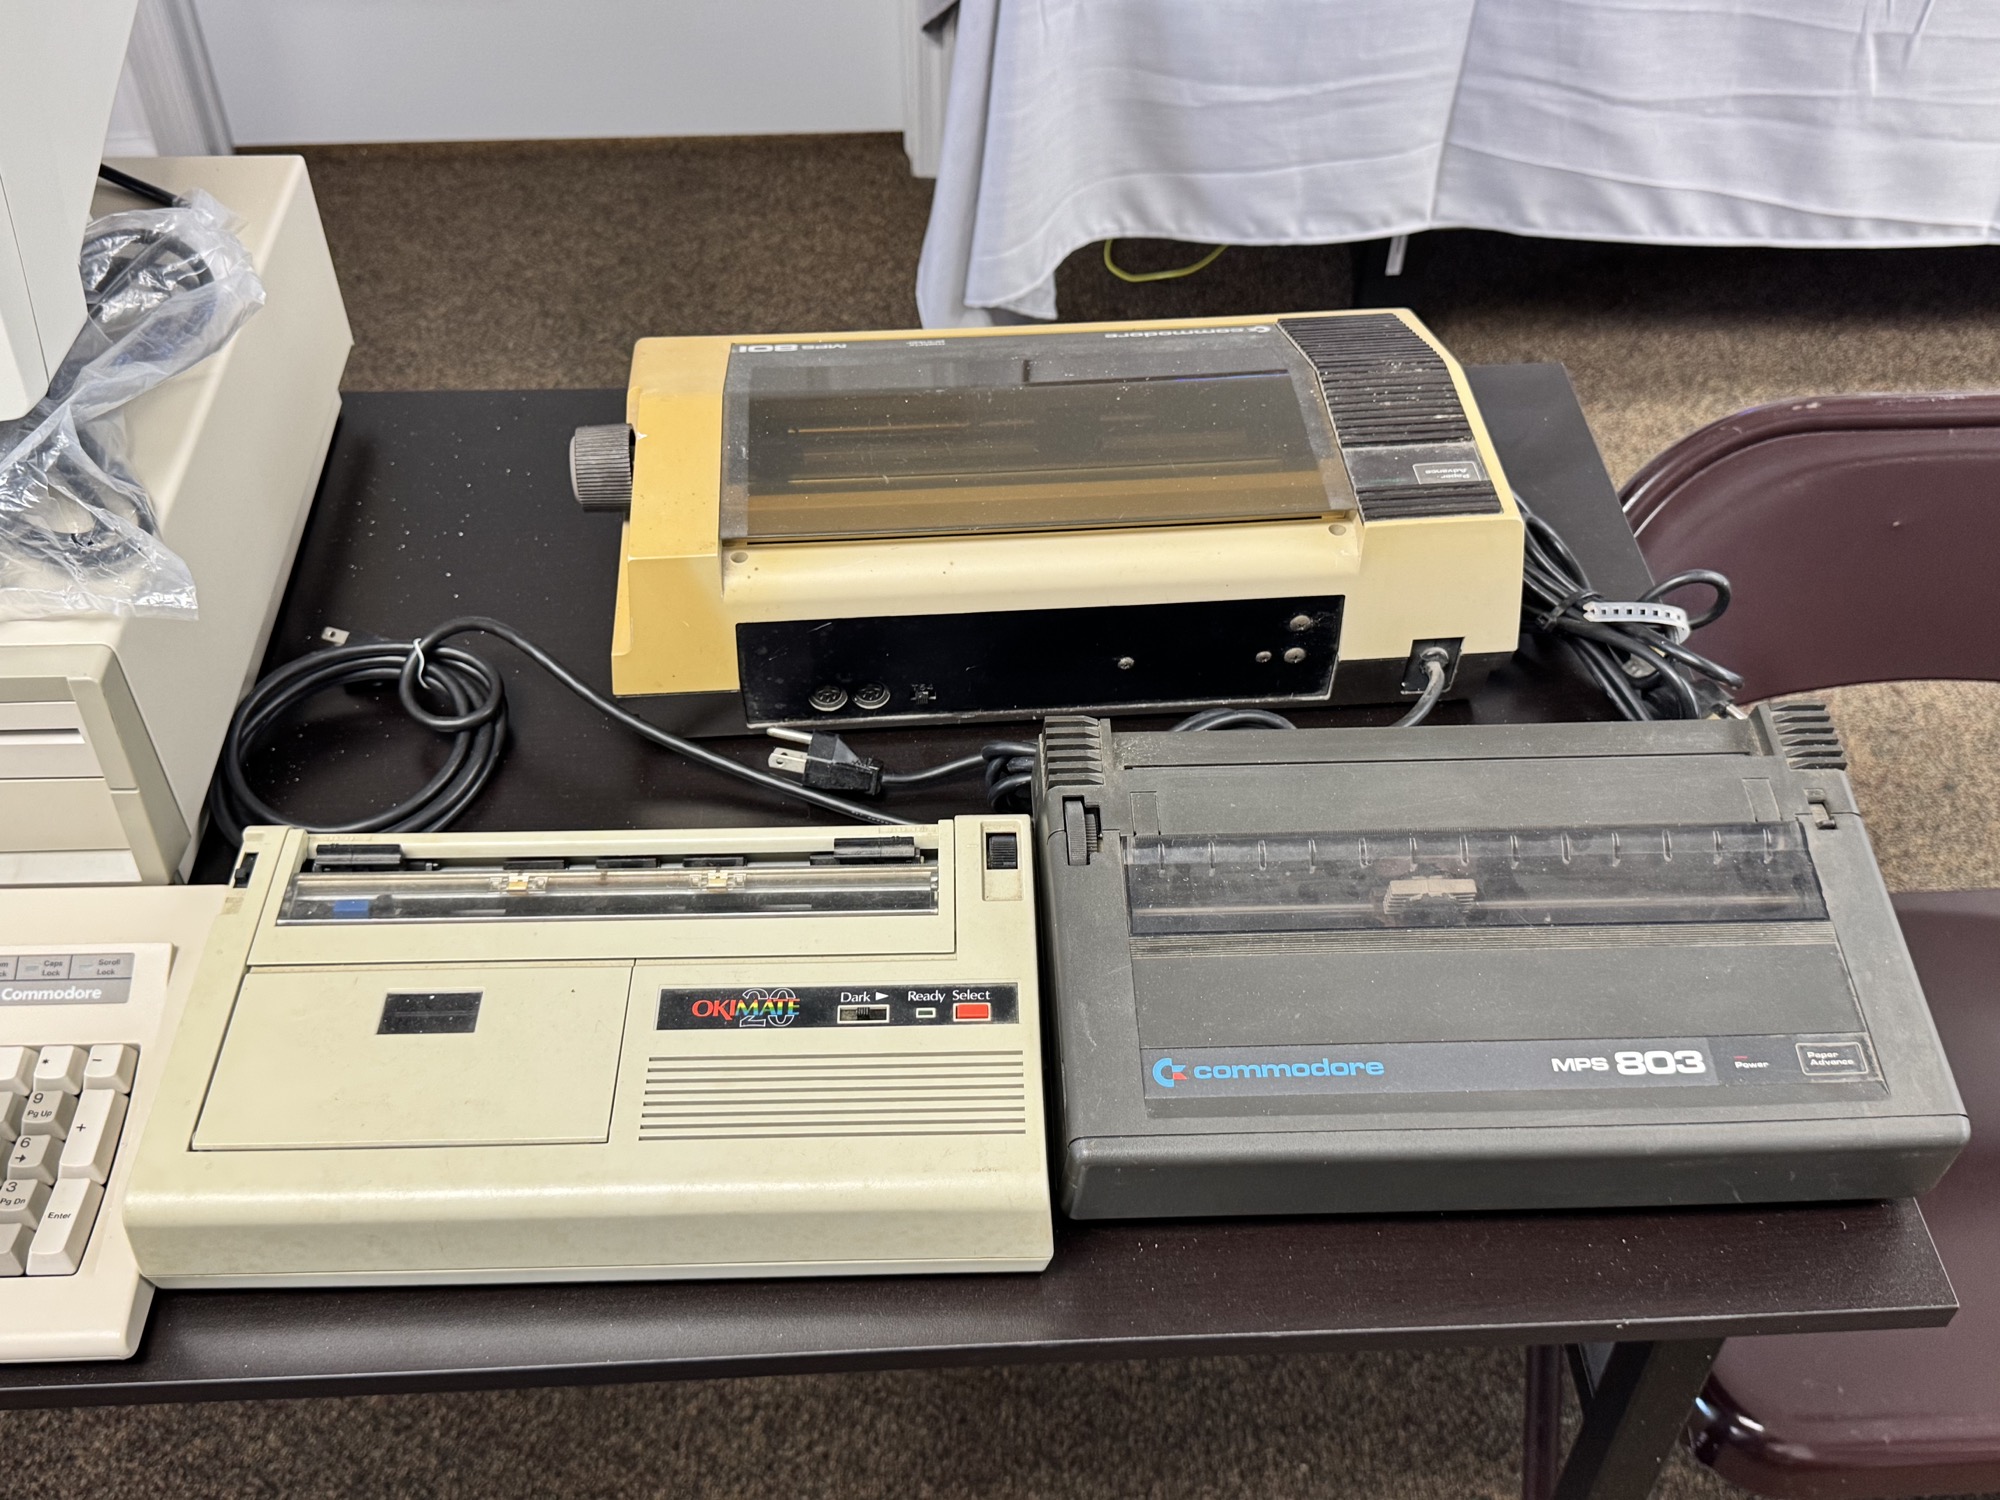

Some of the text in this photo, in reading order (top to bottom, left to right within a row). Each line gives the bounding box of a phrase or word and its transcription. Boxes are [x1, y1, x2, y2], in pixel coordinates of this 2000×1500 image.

[739, 344, 798, 353] 801
[43, 960, 64, 968] Caps
[98, 958, 121, 966] Scroll
[42, 969, 60, 977] Lock
[96, 968, 115, 976] Lock
[1, 986, 103, 1001] Commodore
[840, 991, 871, 1003] Dark
[907, 990, 946, 1003] Ready
[952, 989, 990, 1001] Select
[691, 987, 801, 1028] OKIMATE 20
[1806, 1051, 1839, 1059] Paper
[1551, 1050, 1707, 1076] MPS 803
[1734, 1061, 1770, 1069] Power
[1810, 1059, 1855, 1067] Advance
[1193, 1058, 1385, 1080] commodore
[32, 1092, 44, 1104] 9
[27, 1109, 53, 1119] Pg Up
[20, 1137, 31, 1148] 6
[5, 1181, 18, 1193] 3
[0, 1198, 11, 1206] Pg
[47, 1211, 72, 1219] Enter
